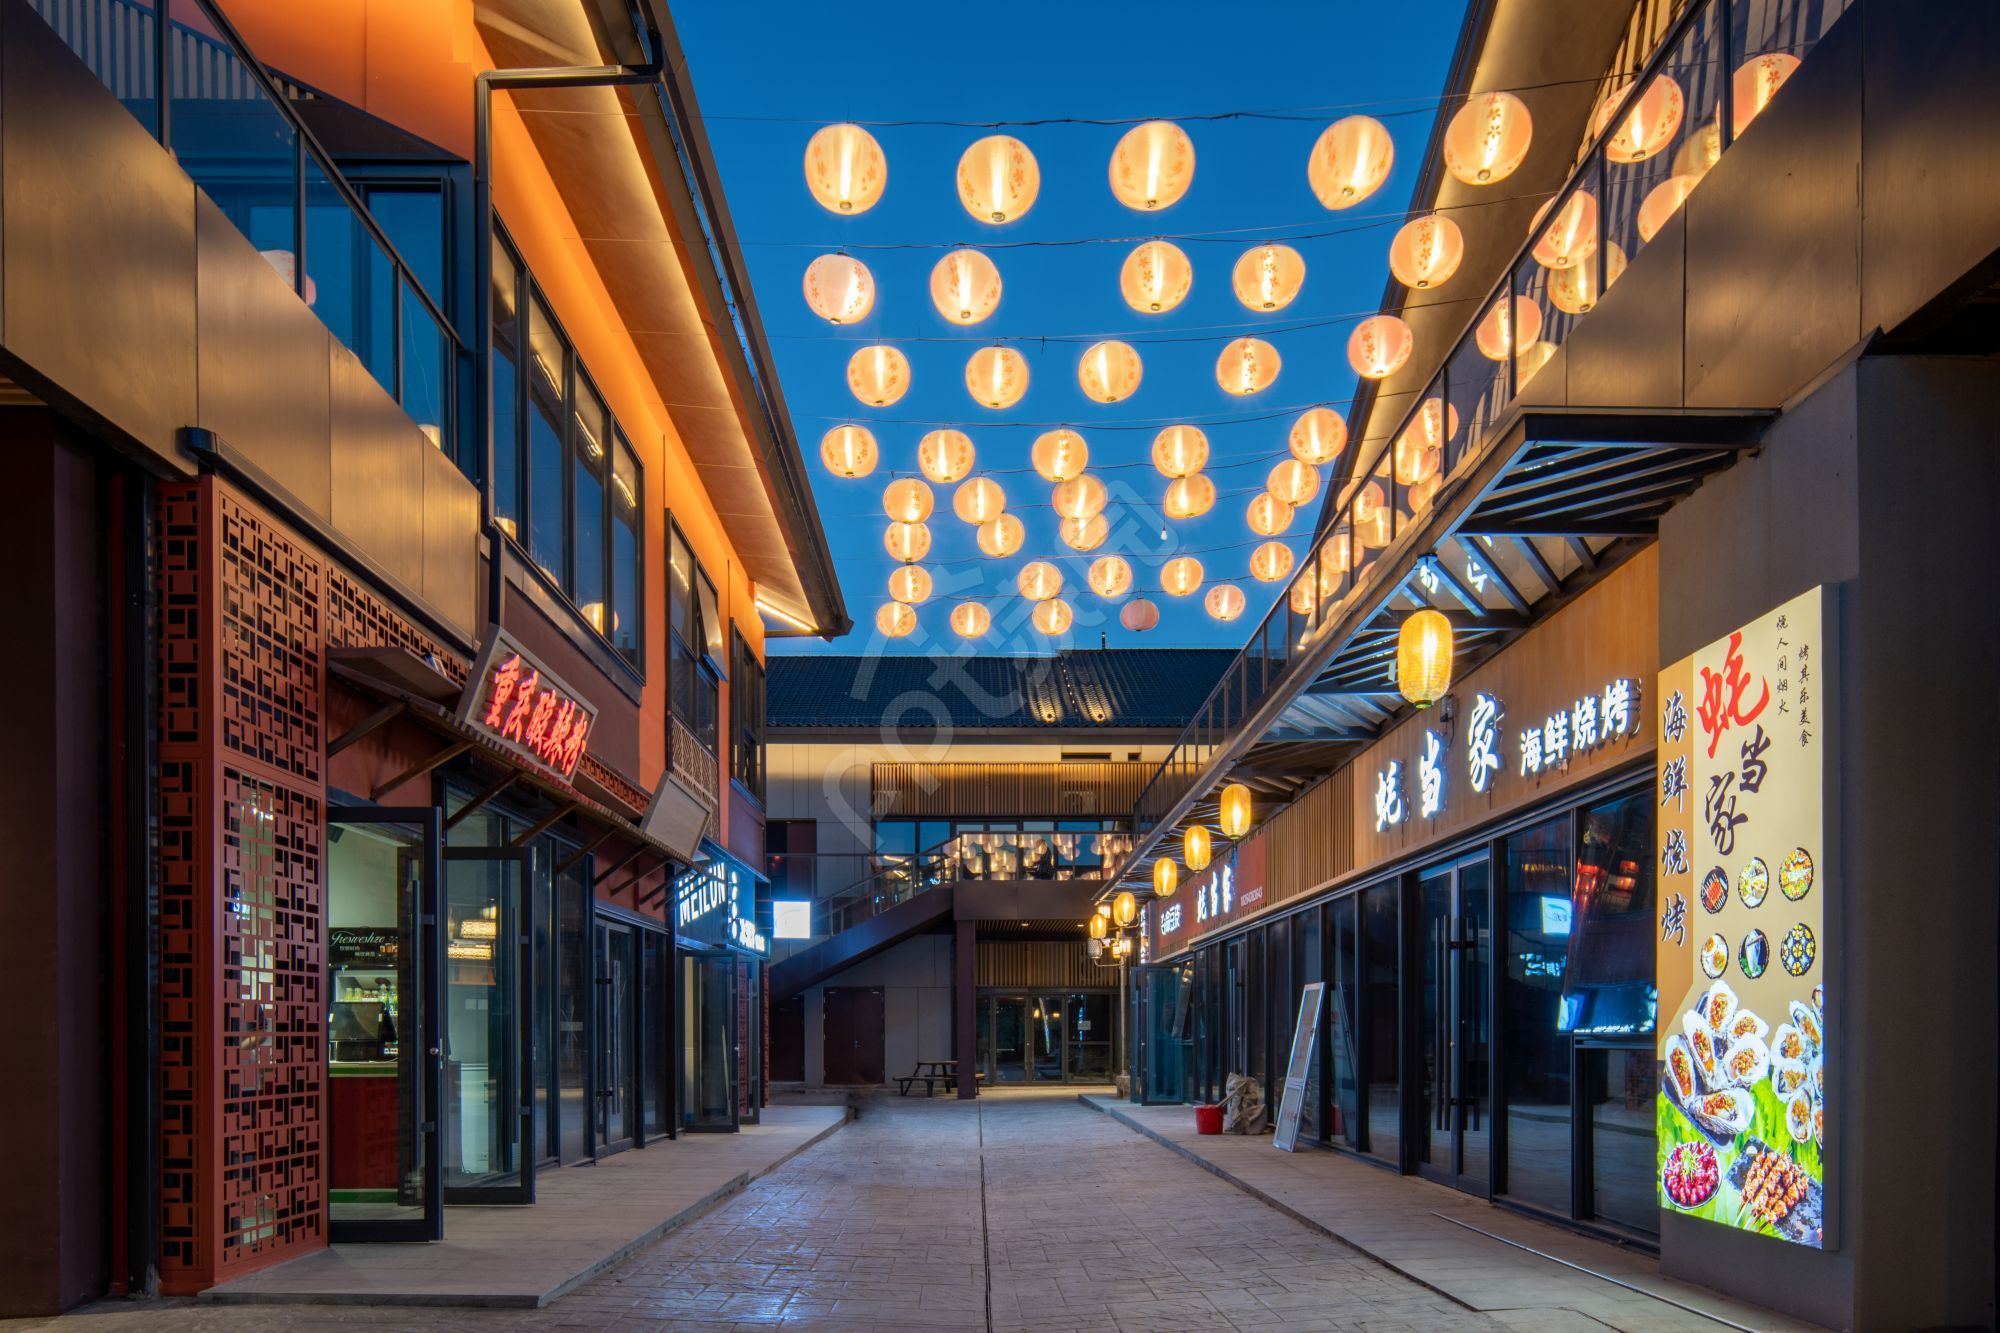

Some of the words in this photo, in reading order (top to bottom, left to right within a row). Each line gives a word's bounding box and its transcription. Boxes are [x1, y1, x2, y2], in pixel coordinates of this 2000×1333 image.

[485, 654, 587, 777] 重庆酸辣粉
[1776, 615, 1790, 716] 烧人间烟火
[1375, 693, 1499, 833] 蚝当家
[1520, 678, 1631, 777] 海鲜烧烤
[1661, 688, 1690, 948] 海鲜烧烤
